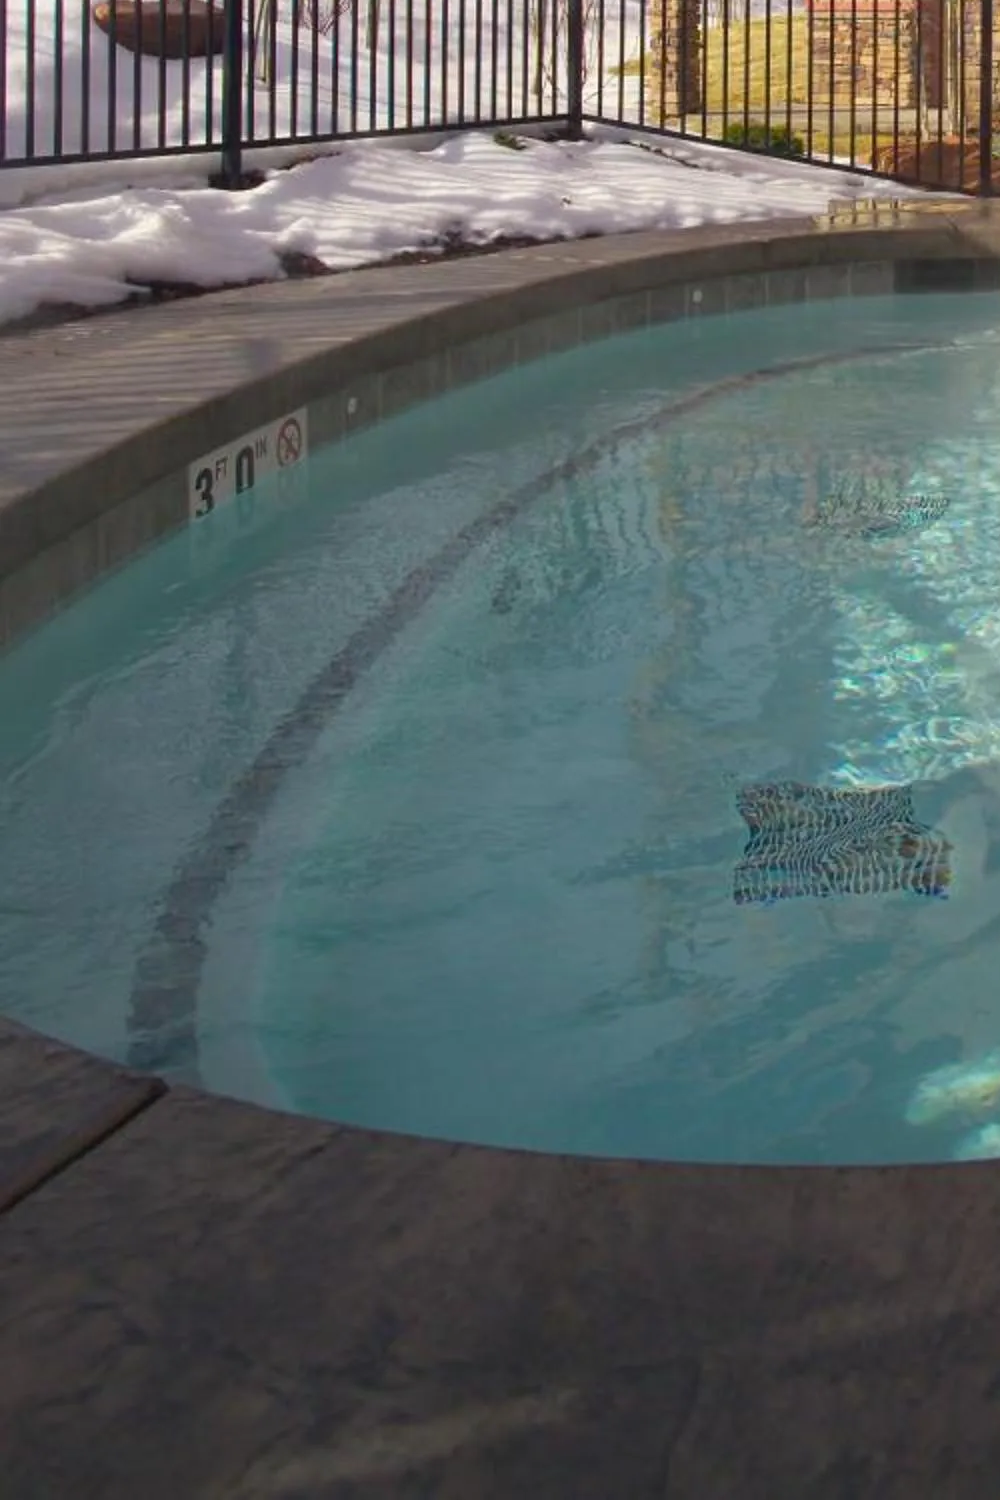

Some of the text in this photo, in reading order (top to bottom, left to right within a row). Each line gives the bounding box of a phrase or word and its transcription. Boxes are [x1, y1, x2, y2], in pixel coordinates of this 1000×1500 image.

[195, 467, 215, 519] 3
[215, 456, 229, 482] FT
[235, 445, 255, 495] 0
